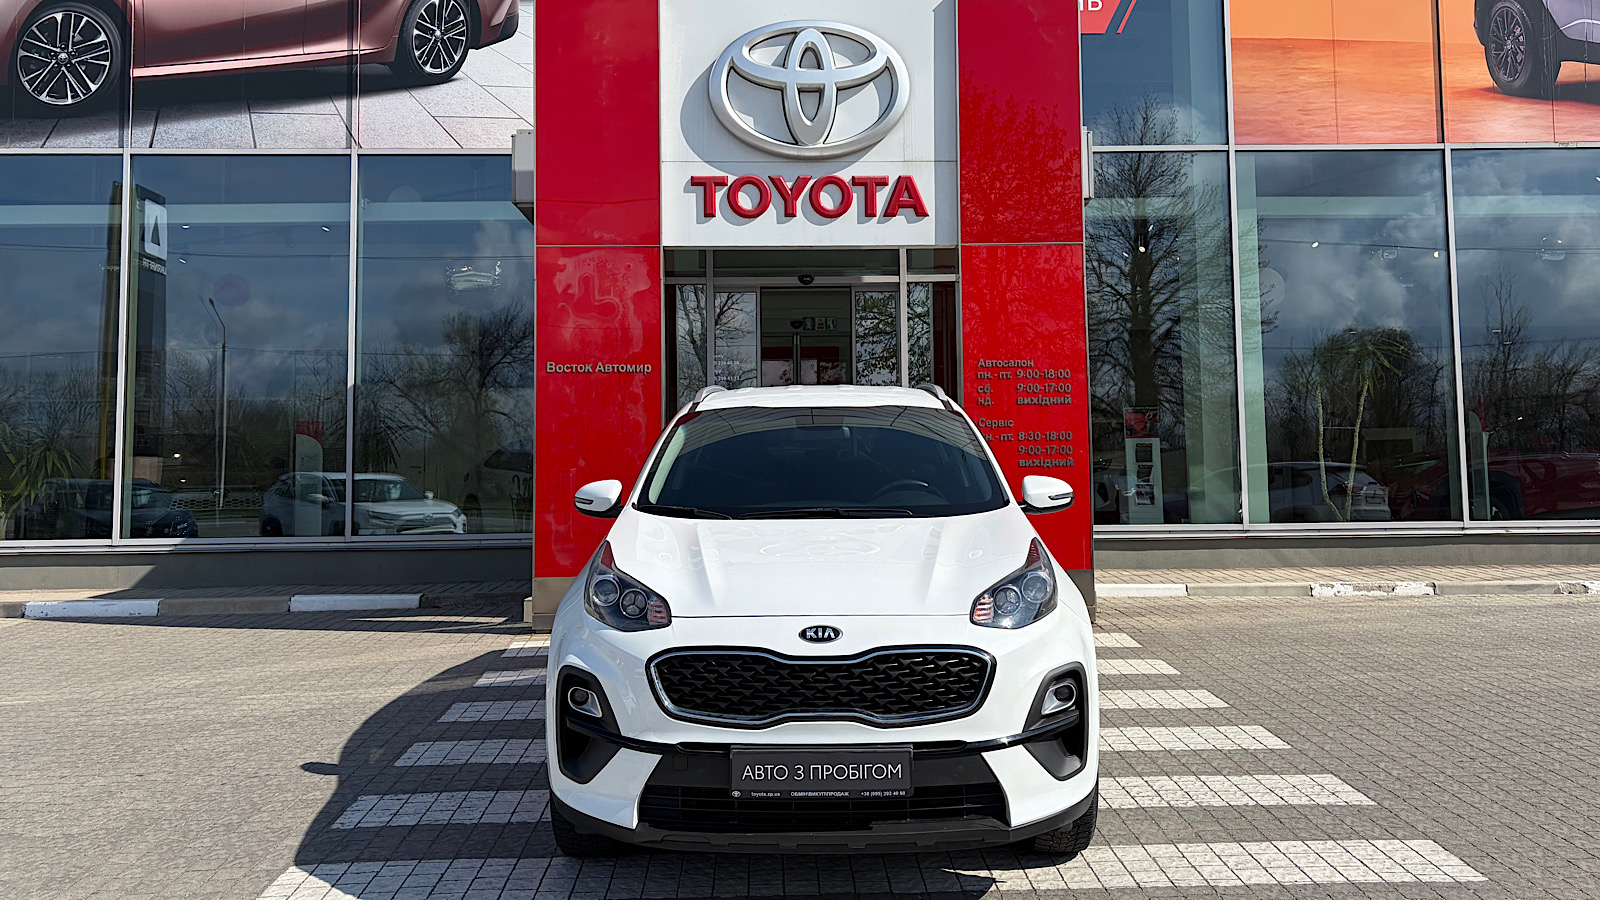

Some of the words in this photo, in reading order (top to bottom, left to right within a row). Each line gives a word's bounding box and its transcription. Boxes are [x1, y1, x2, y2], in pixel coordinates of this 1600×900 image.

[691, 174, 930, 219] TOYOTA
[546, 361, 593, 373] Восток
[595, 361, 652, 375] Автомир
[977, 358, 1034, 368] Автосалон
[1016, 369, 1071, 379] 9:00-18:00
[977, 383, 994, 393] сб.
[1016, 383, 1072, 393] 9:00-17:00
[977, 397, 995, 407] нд.
[1017, 394, 1072, 406] вихідний
[978, 418, 1014, 429] Сервіс
[1018, 431, 1073, 441] 8:30-18:00
[1018, 445, 1074, 455] 9:00-17:00
[1018, 457, 1075, 469] вихідний
[805, 627, 836, 639] KIA
[742, 764, 789, 780] АВТО
[810, 763, 903, 780] ПРОБІГОМ
